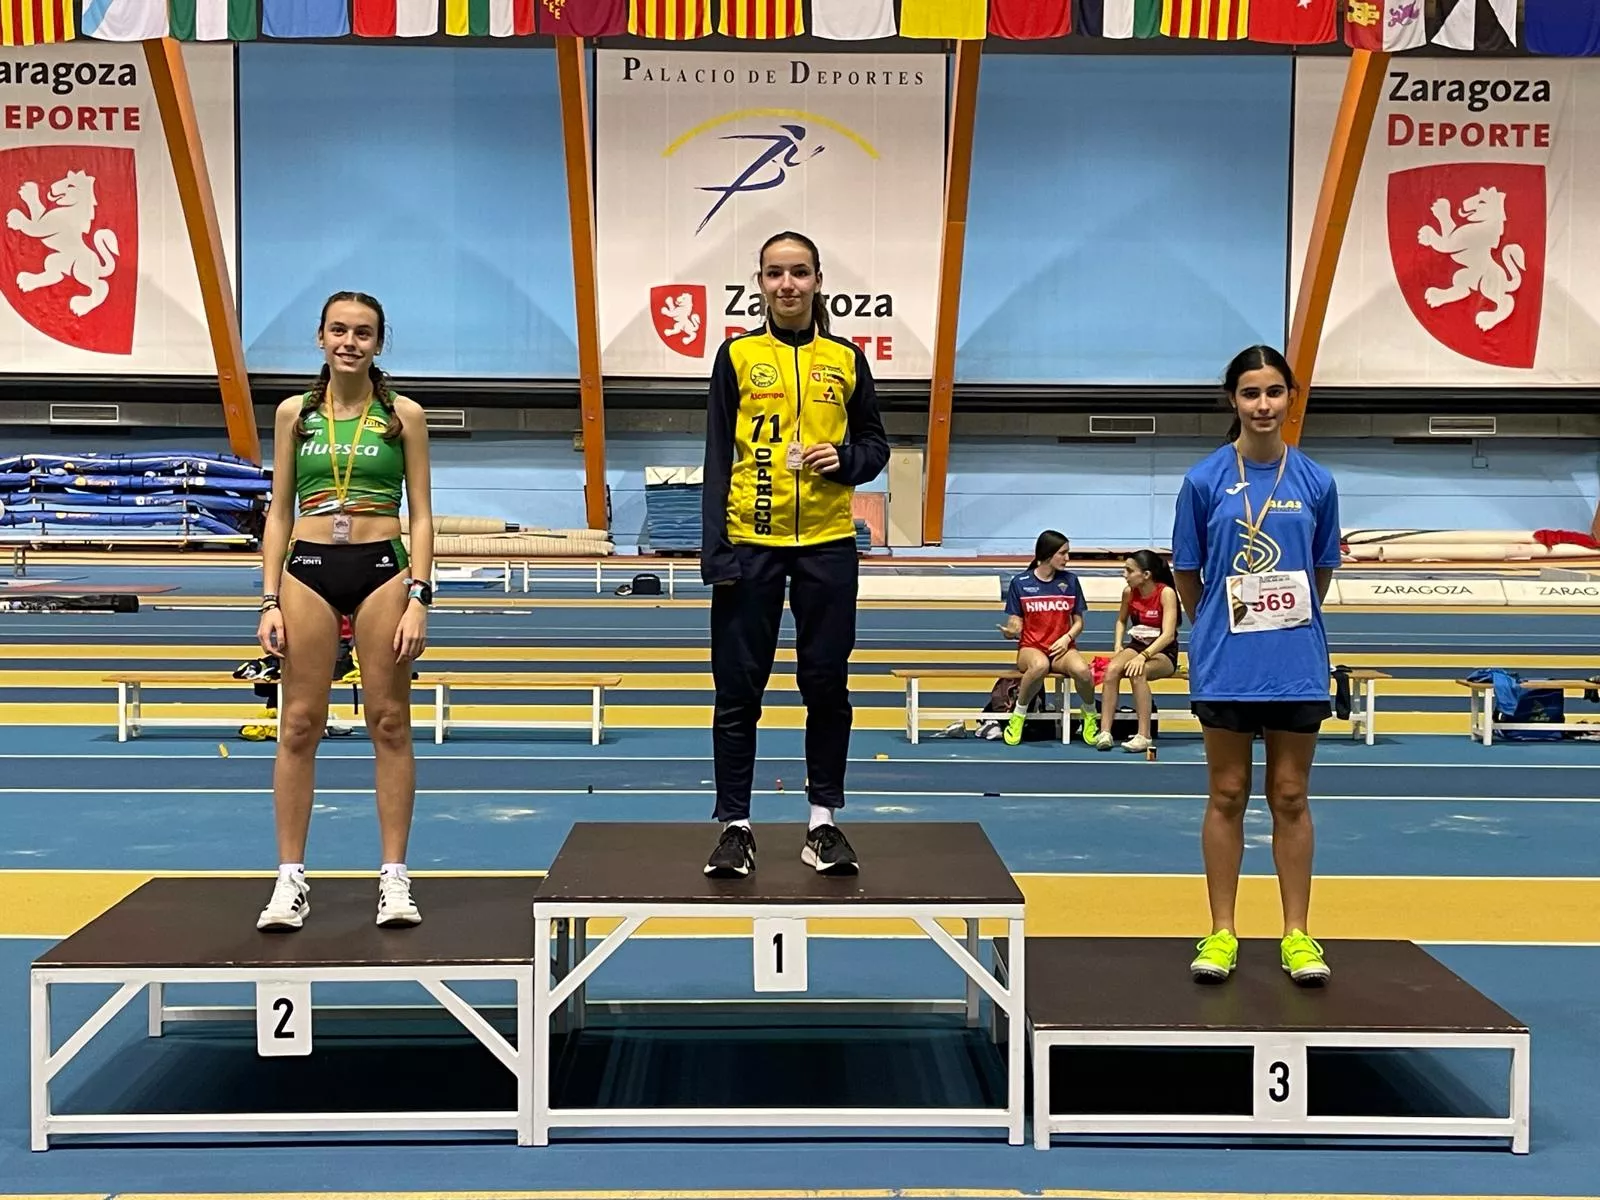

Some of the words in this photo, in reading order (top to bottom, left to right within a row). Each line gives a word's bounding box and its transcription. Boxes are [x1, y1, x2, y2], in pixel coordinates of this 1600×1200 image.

[622, 57, 735, 84] PALACIO
[748, 69, 777, 84] DE
[789, 60, 924, 85] DEPORTES
[1388, 71, 1550, 112] Zaragoza
[1387, 113, 1550, 148] DEPORTE
[724, 284, 893, 318] Zaoza
[751, 413, 783, 444] 71
[300, 440, 379, 457] Huesca
[754, 447, 772, 536] SCORPIO
[1252, 592, 1296, 613] 569
[1370, 584, 1473, 595] ZARAGOZA
[772, 932, 783, 974] 1
[272, 997, 295, 1039] 2
[1268, 1060, 1290, 1103] 3
